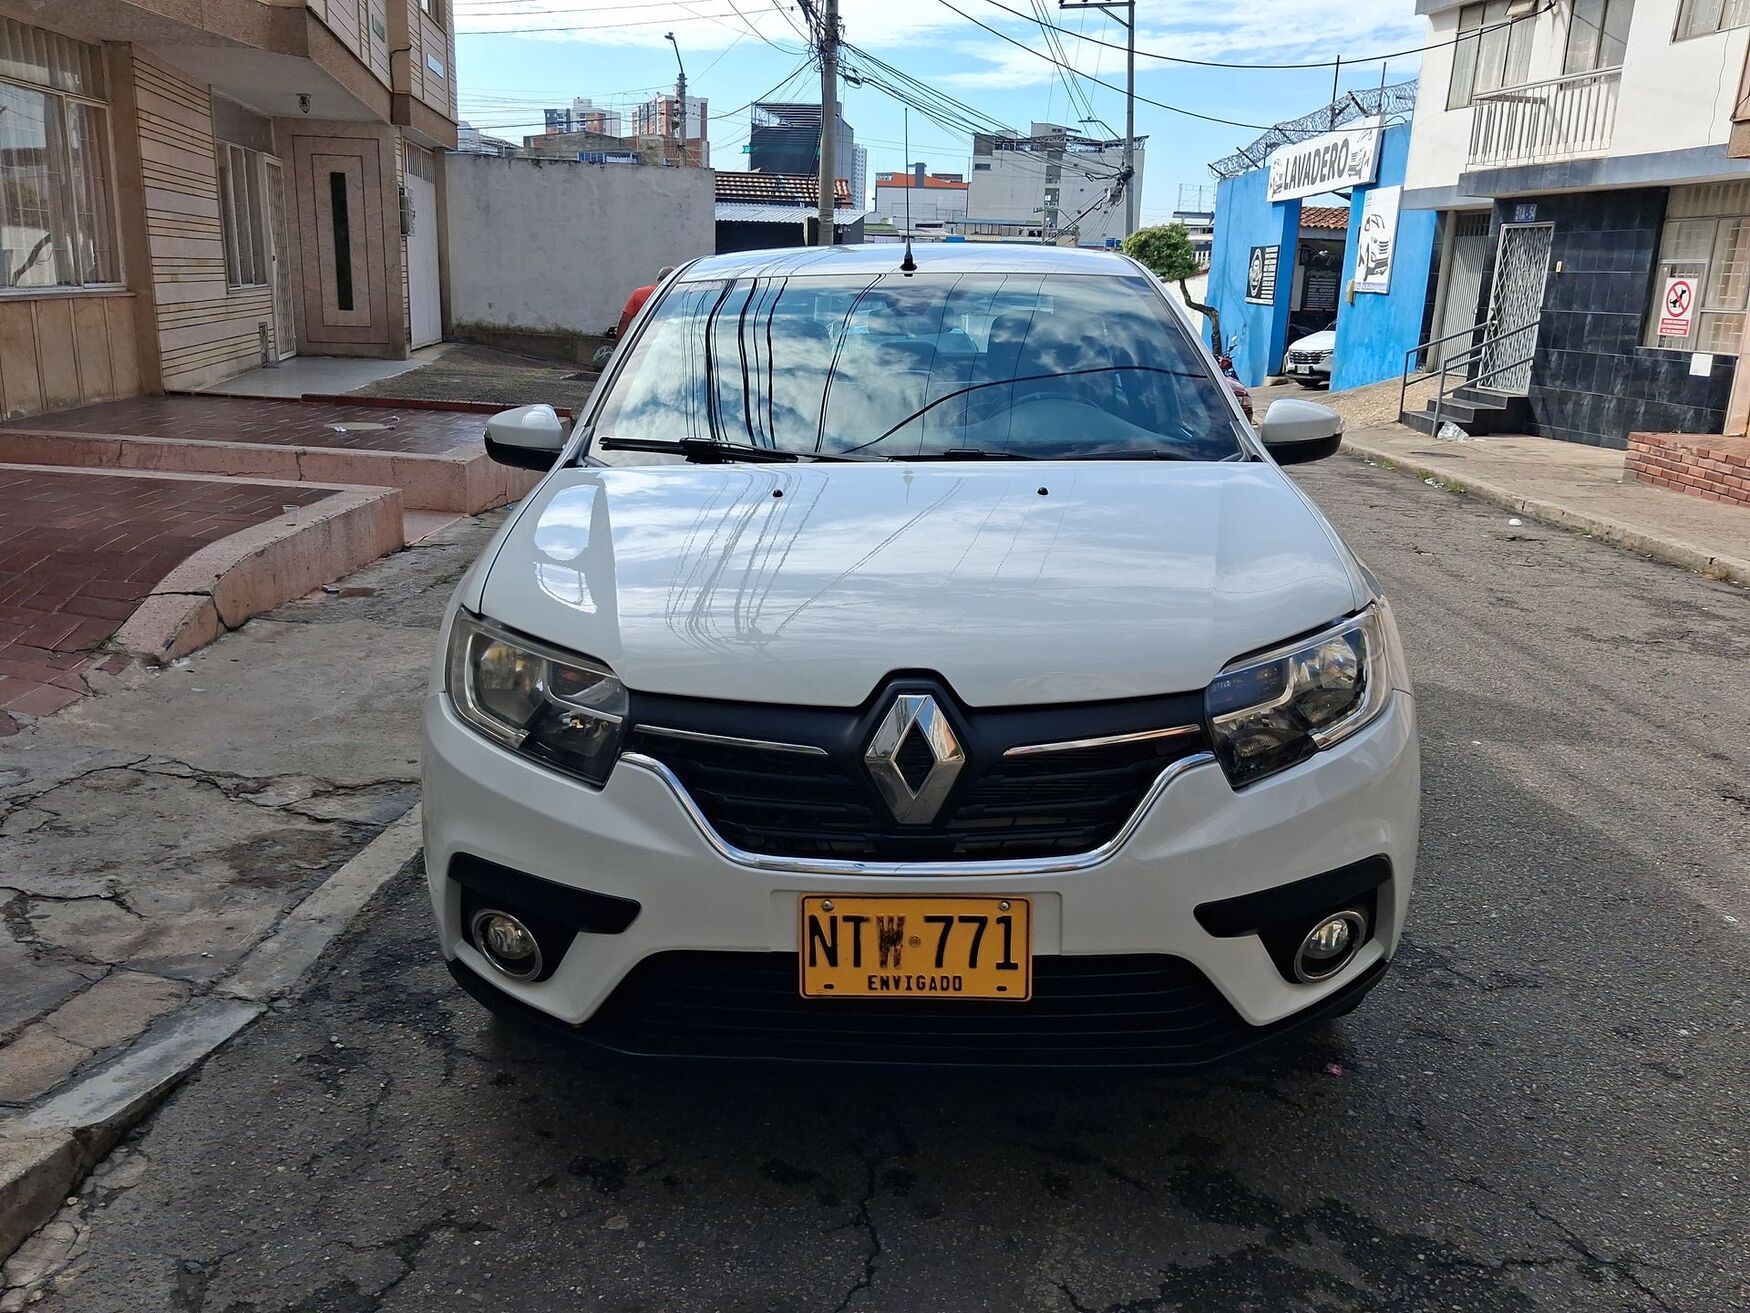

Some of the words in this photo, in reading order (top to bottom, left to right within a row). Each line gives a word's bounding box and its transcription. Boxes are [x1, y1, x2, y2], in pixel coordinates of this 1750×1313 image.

[1284, 138, 1350, 190] LAVADERO
[808, 914, 905, 969] NTW
[924, 914, 1019, 970] 771
[867, 975, 963, 992] ENVIGADO
